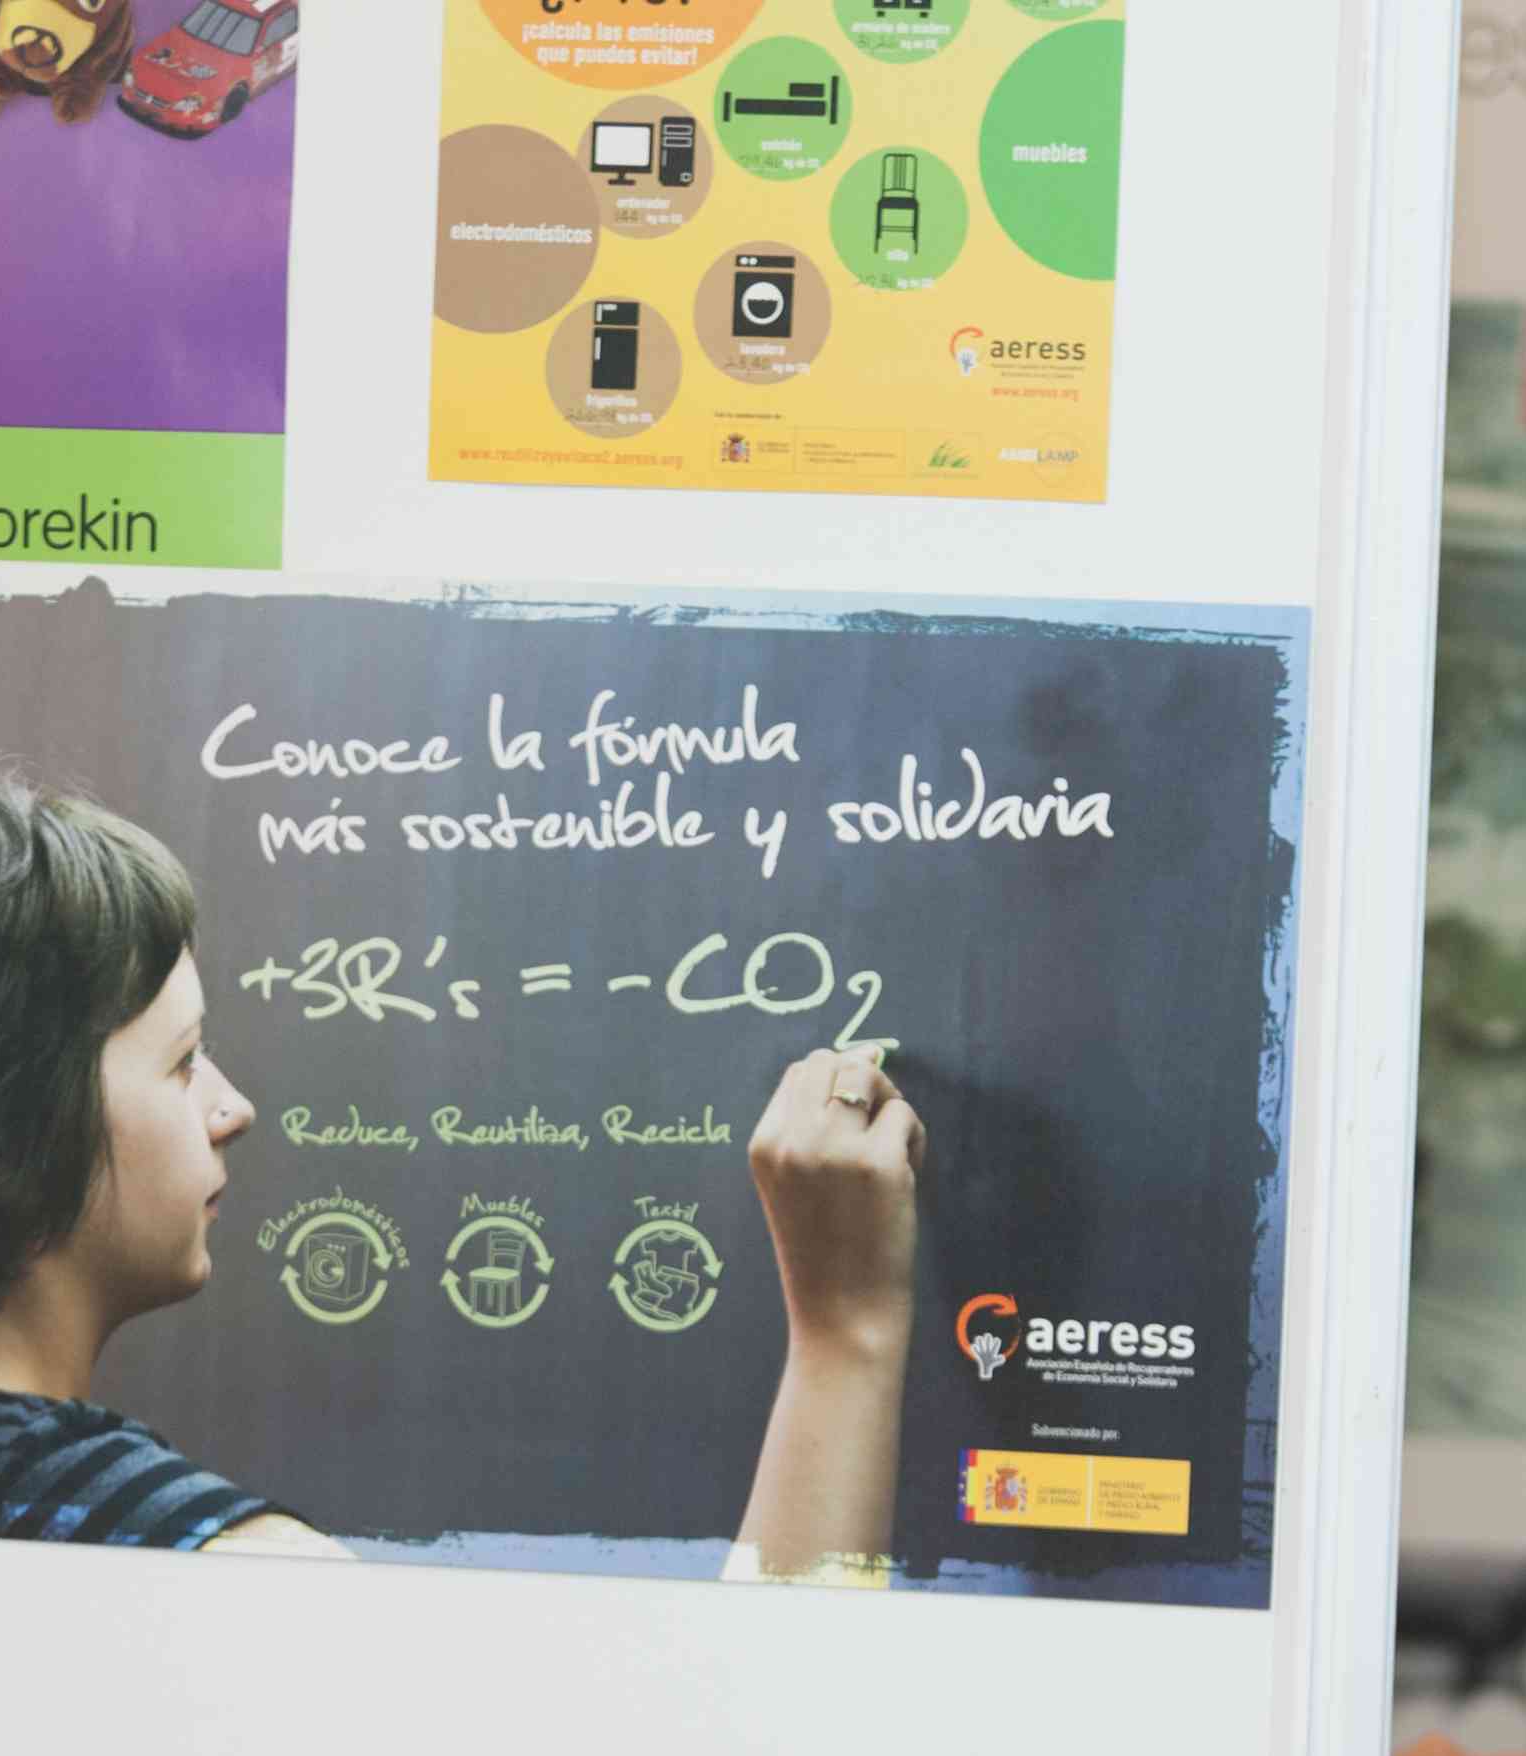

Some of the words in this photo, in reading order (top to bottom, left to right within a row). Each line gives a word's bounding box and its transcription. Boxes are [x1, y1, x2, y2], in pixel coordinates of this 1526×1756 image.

[597, 21, 622, 40] las
[628, 25, 714, 44] emisiones
[537, 46, 570, 65] que
[574, 45, 635, 67] puedes
[1012, 143, 1088, 164] muebles
[450, 222, 593, 243] electrodomésticos
[990, 337, 1086, 361] aeress
[201, 703, 461, 780] Conoce
[489, 693, 545, 770] la
[571, 684, 799, 785] fórmula
[260, 797, 367, 862] más
[407, 770, 715, 851] sostenible
[744, 808, 786, 878] y
[828, 748, 1114, 842] solidaria
[281, 1105, 420, 1152] Reduce,
[431, 1105, 589, 1151] Reutiliza,
[602, 1104, 731, 1146] Recicla
[459, 1193, 546, 1230] Muebles
[634, 1195, 699, 1223] Textil
[256, 1185, 410, 1269] Electrodomésticos
[1026, 1316, 1195, 1360] aeress
